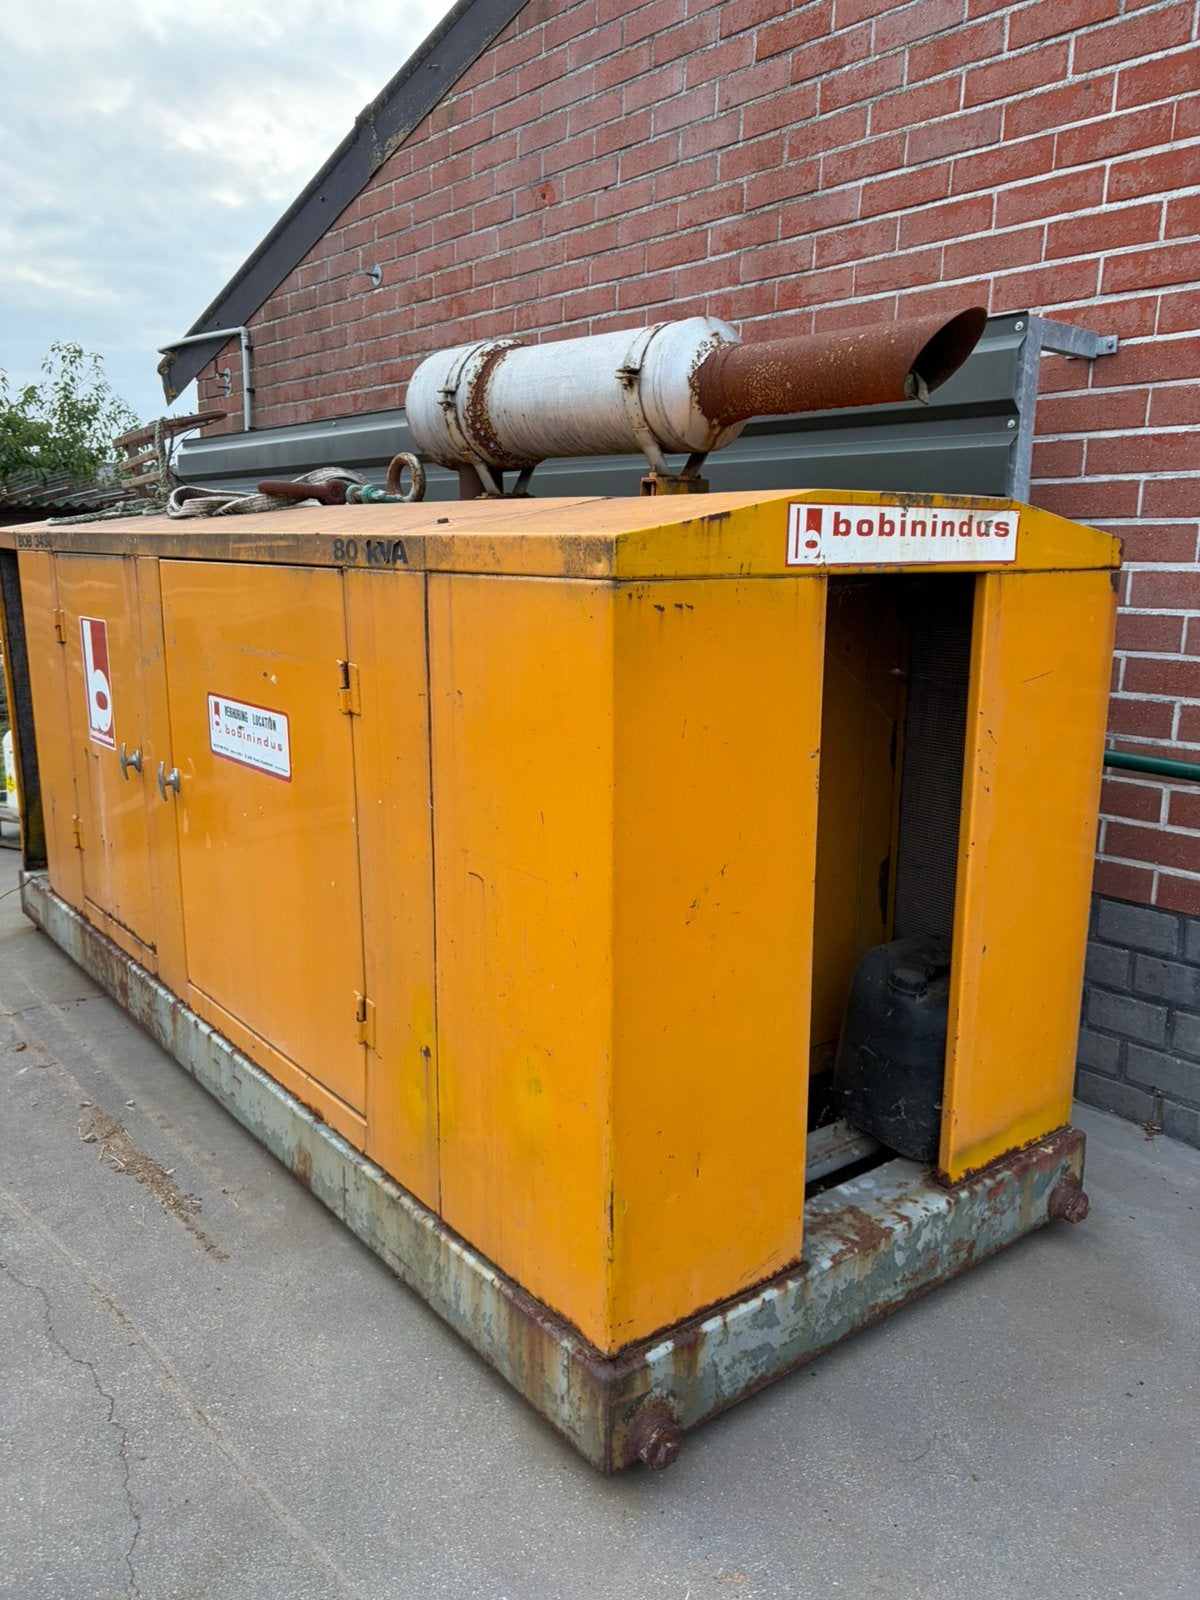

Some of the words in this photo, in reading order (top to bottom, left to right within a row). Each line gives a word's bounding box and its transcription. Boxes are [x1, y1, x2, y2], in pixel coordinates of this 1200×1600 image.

[832, 511, 1010, 538] bobinindus
[18, 534, 32, 548] BOB
[333, 537, 358, 562] 80
[252, 713, 277, 731] LOCATION
[225, 723, 283, 752] bobinindus
